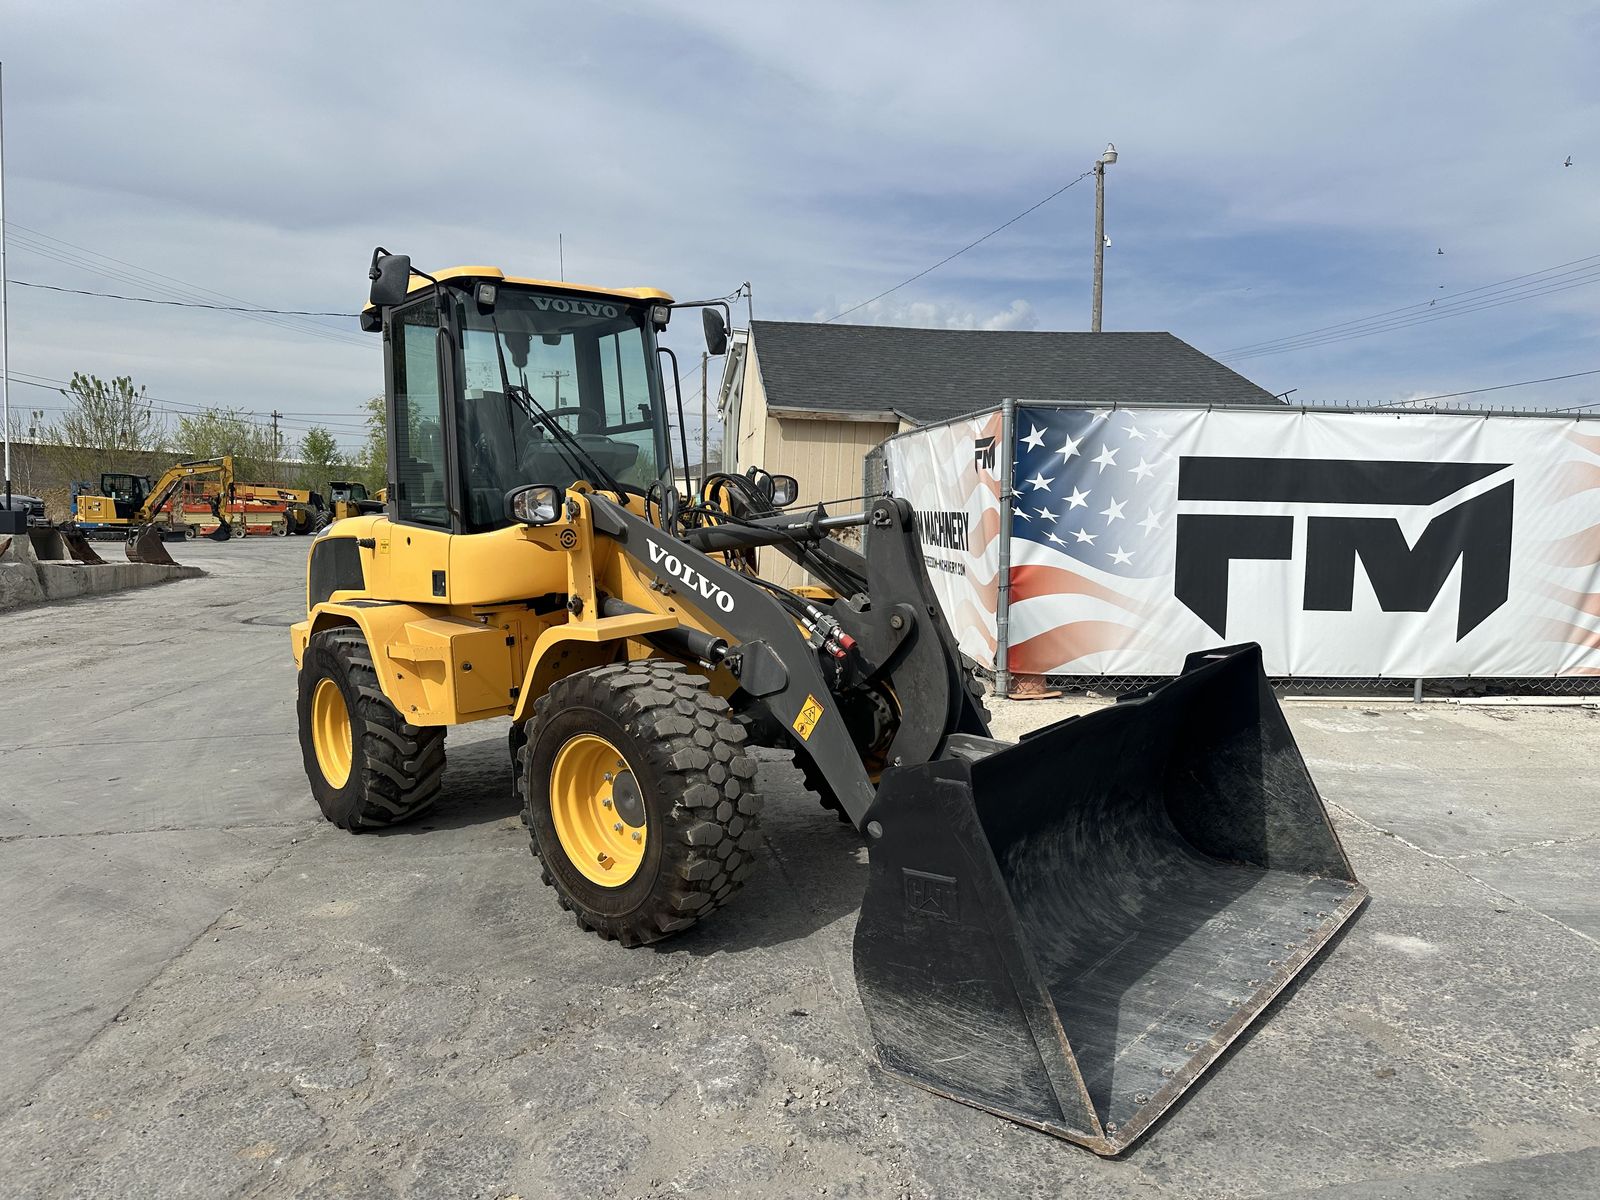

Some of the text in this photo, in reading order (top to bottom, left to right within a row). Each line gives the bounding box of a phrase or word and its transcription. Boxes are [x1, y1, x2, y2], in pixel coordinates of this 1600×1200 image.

[528, 296, 619, 319] VOLVO
[974, 436, 996, 475] FM
[923, 510, 969, 551] MACHNERY
[1174, 456, 1515, 643] FM
[646, 538, 735, 613] VOLVO
